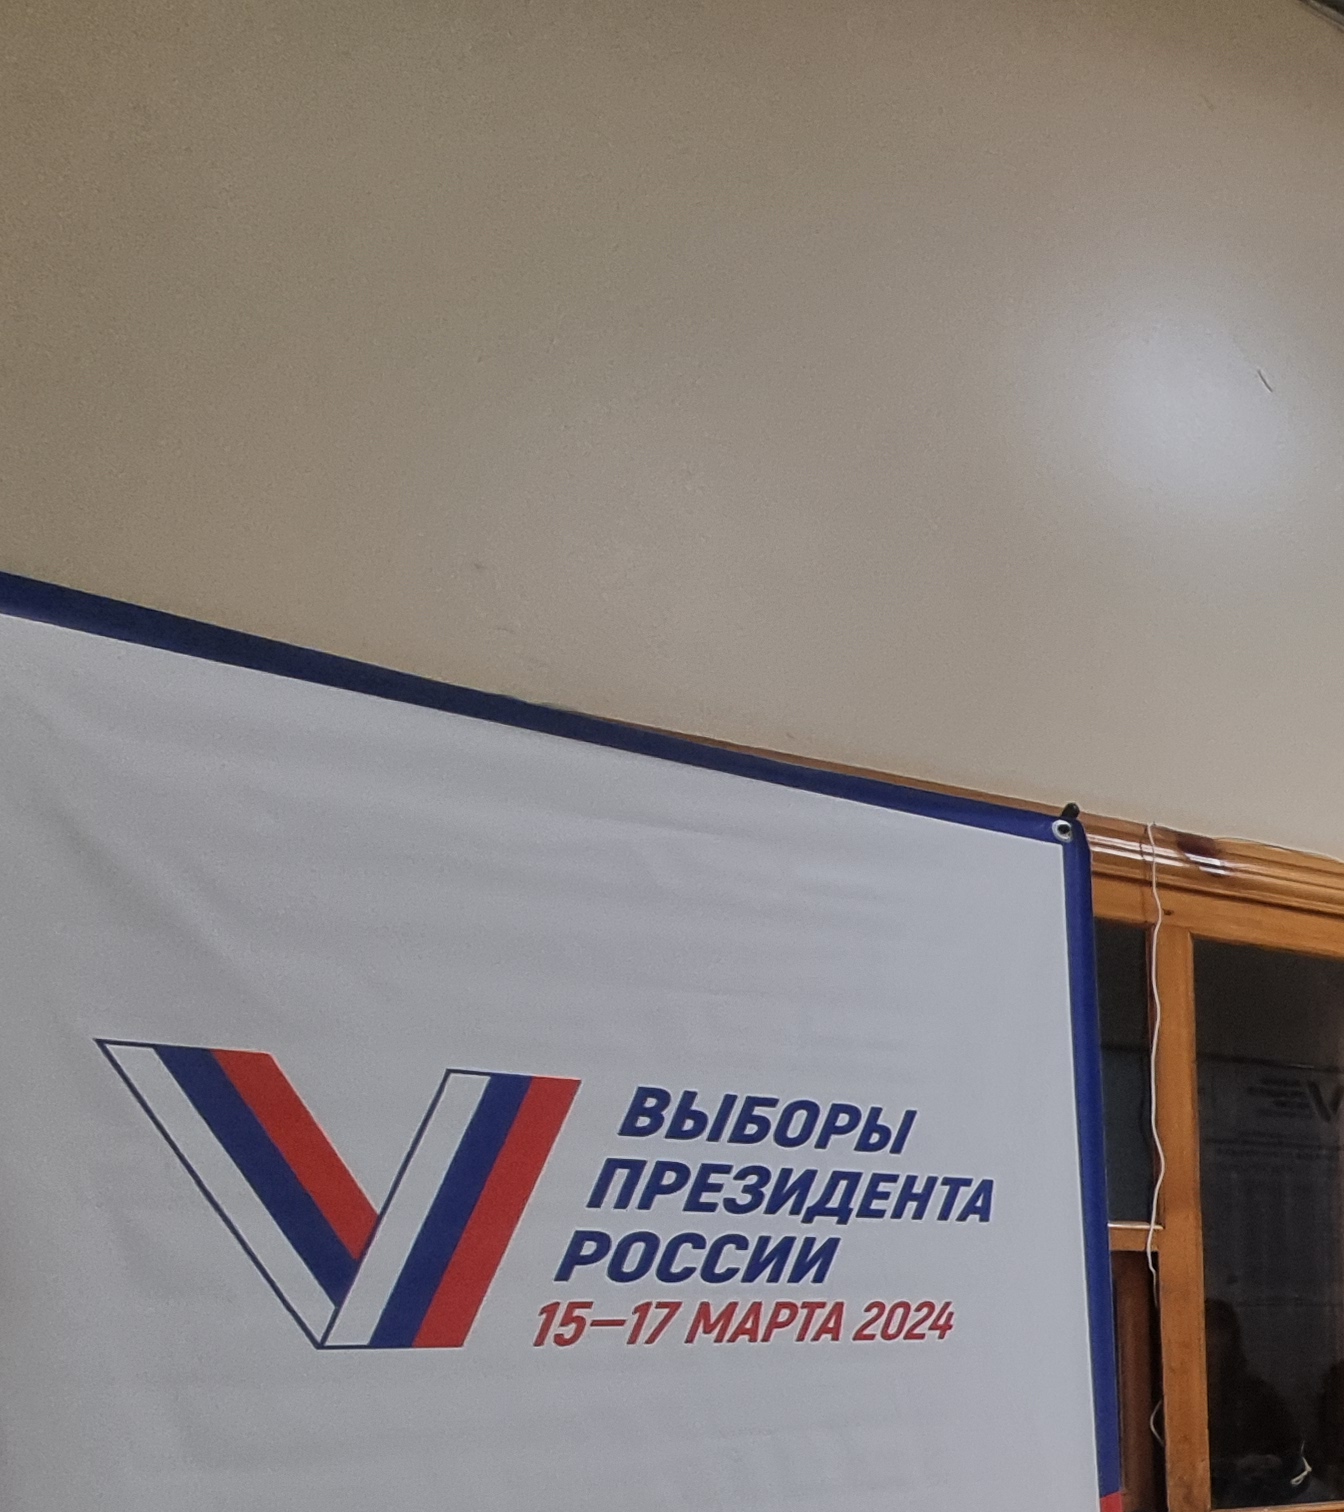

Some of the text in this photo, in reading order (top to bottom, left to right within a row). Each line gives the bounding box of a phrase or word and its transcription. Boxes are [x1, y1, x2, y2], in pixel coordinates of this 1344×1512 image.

[617, 1086, 918, 1154] ВЫБОРЫ
[586, 1157, 994, 1225] ПРЕЗИДЕНТА
[554, 1229, 841, 1284] РОССИИ
[684, 1301, 847, 1344] МАРТА
[852, 1301, 954, 1341] 2024
